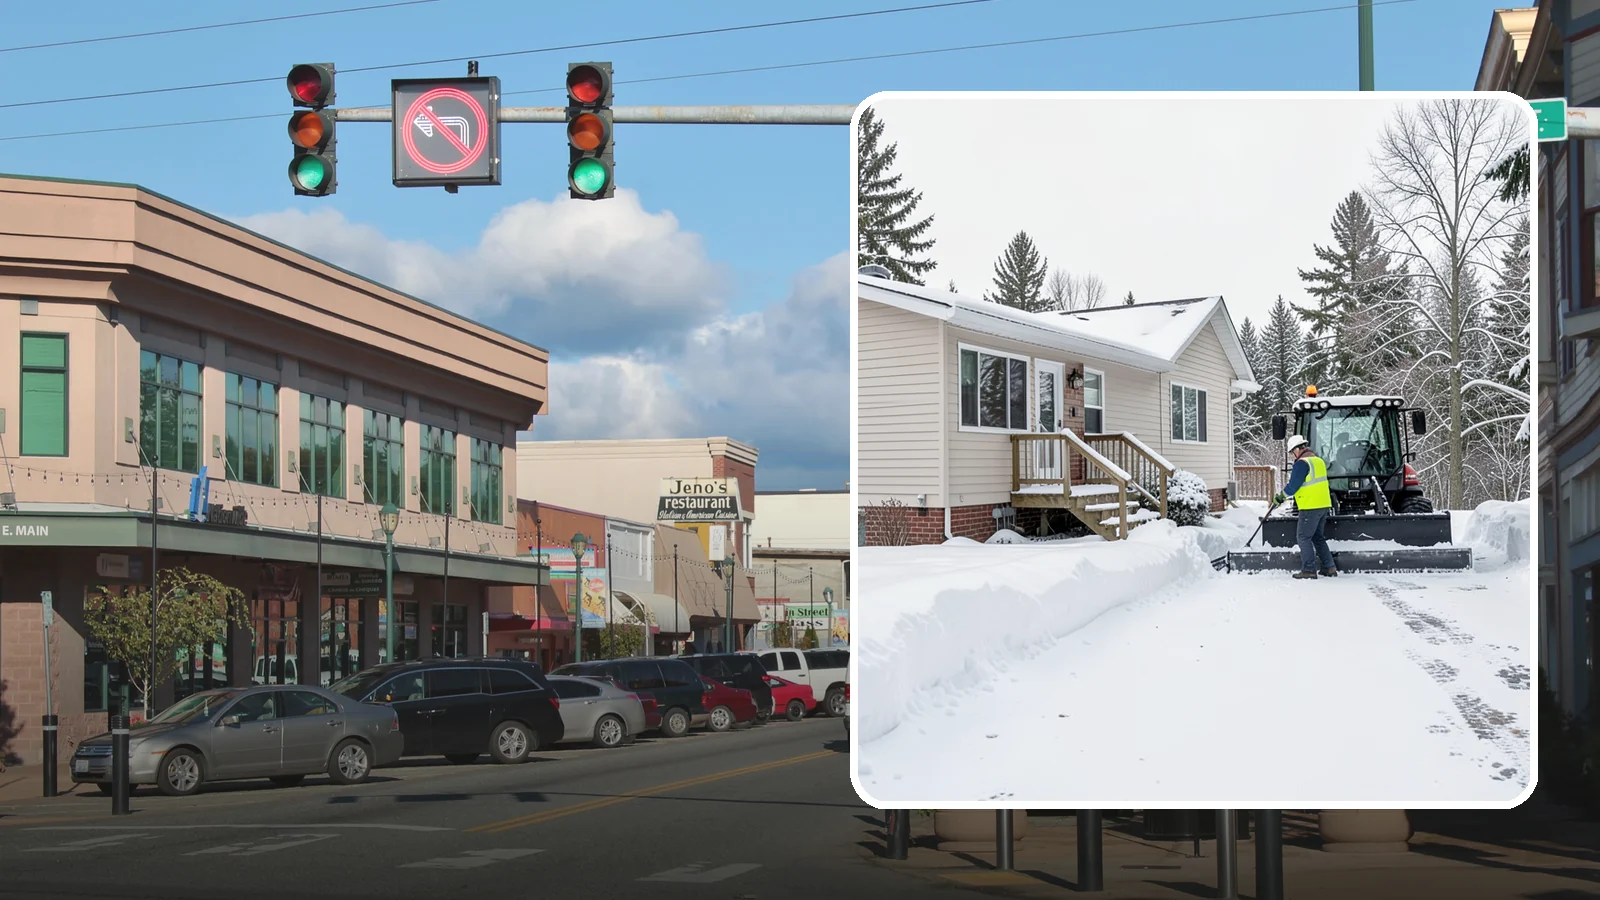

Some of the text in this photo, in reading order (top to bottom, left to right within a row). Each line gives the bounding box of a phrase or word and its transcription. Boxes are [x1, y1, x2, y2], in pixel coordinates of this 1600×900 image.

[669, 480, 728, 495] Jeno's
[665, 496, 731, 509] restaurant
[658, 510, 682, 520] Italian
[686, 510, 714, 519] American
[714, 509, 737, 519] Cuisine
[2, 525, 49, 536] E. MAIN
[797, 607, 829, 617] Street
[790, 619, 823, 627] lass
